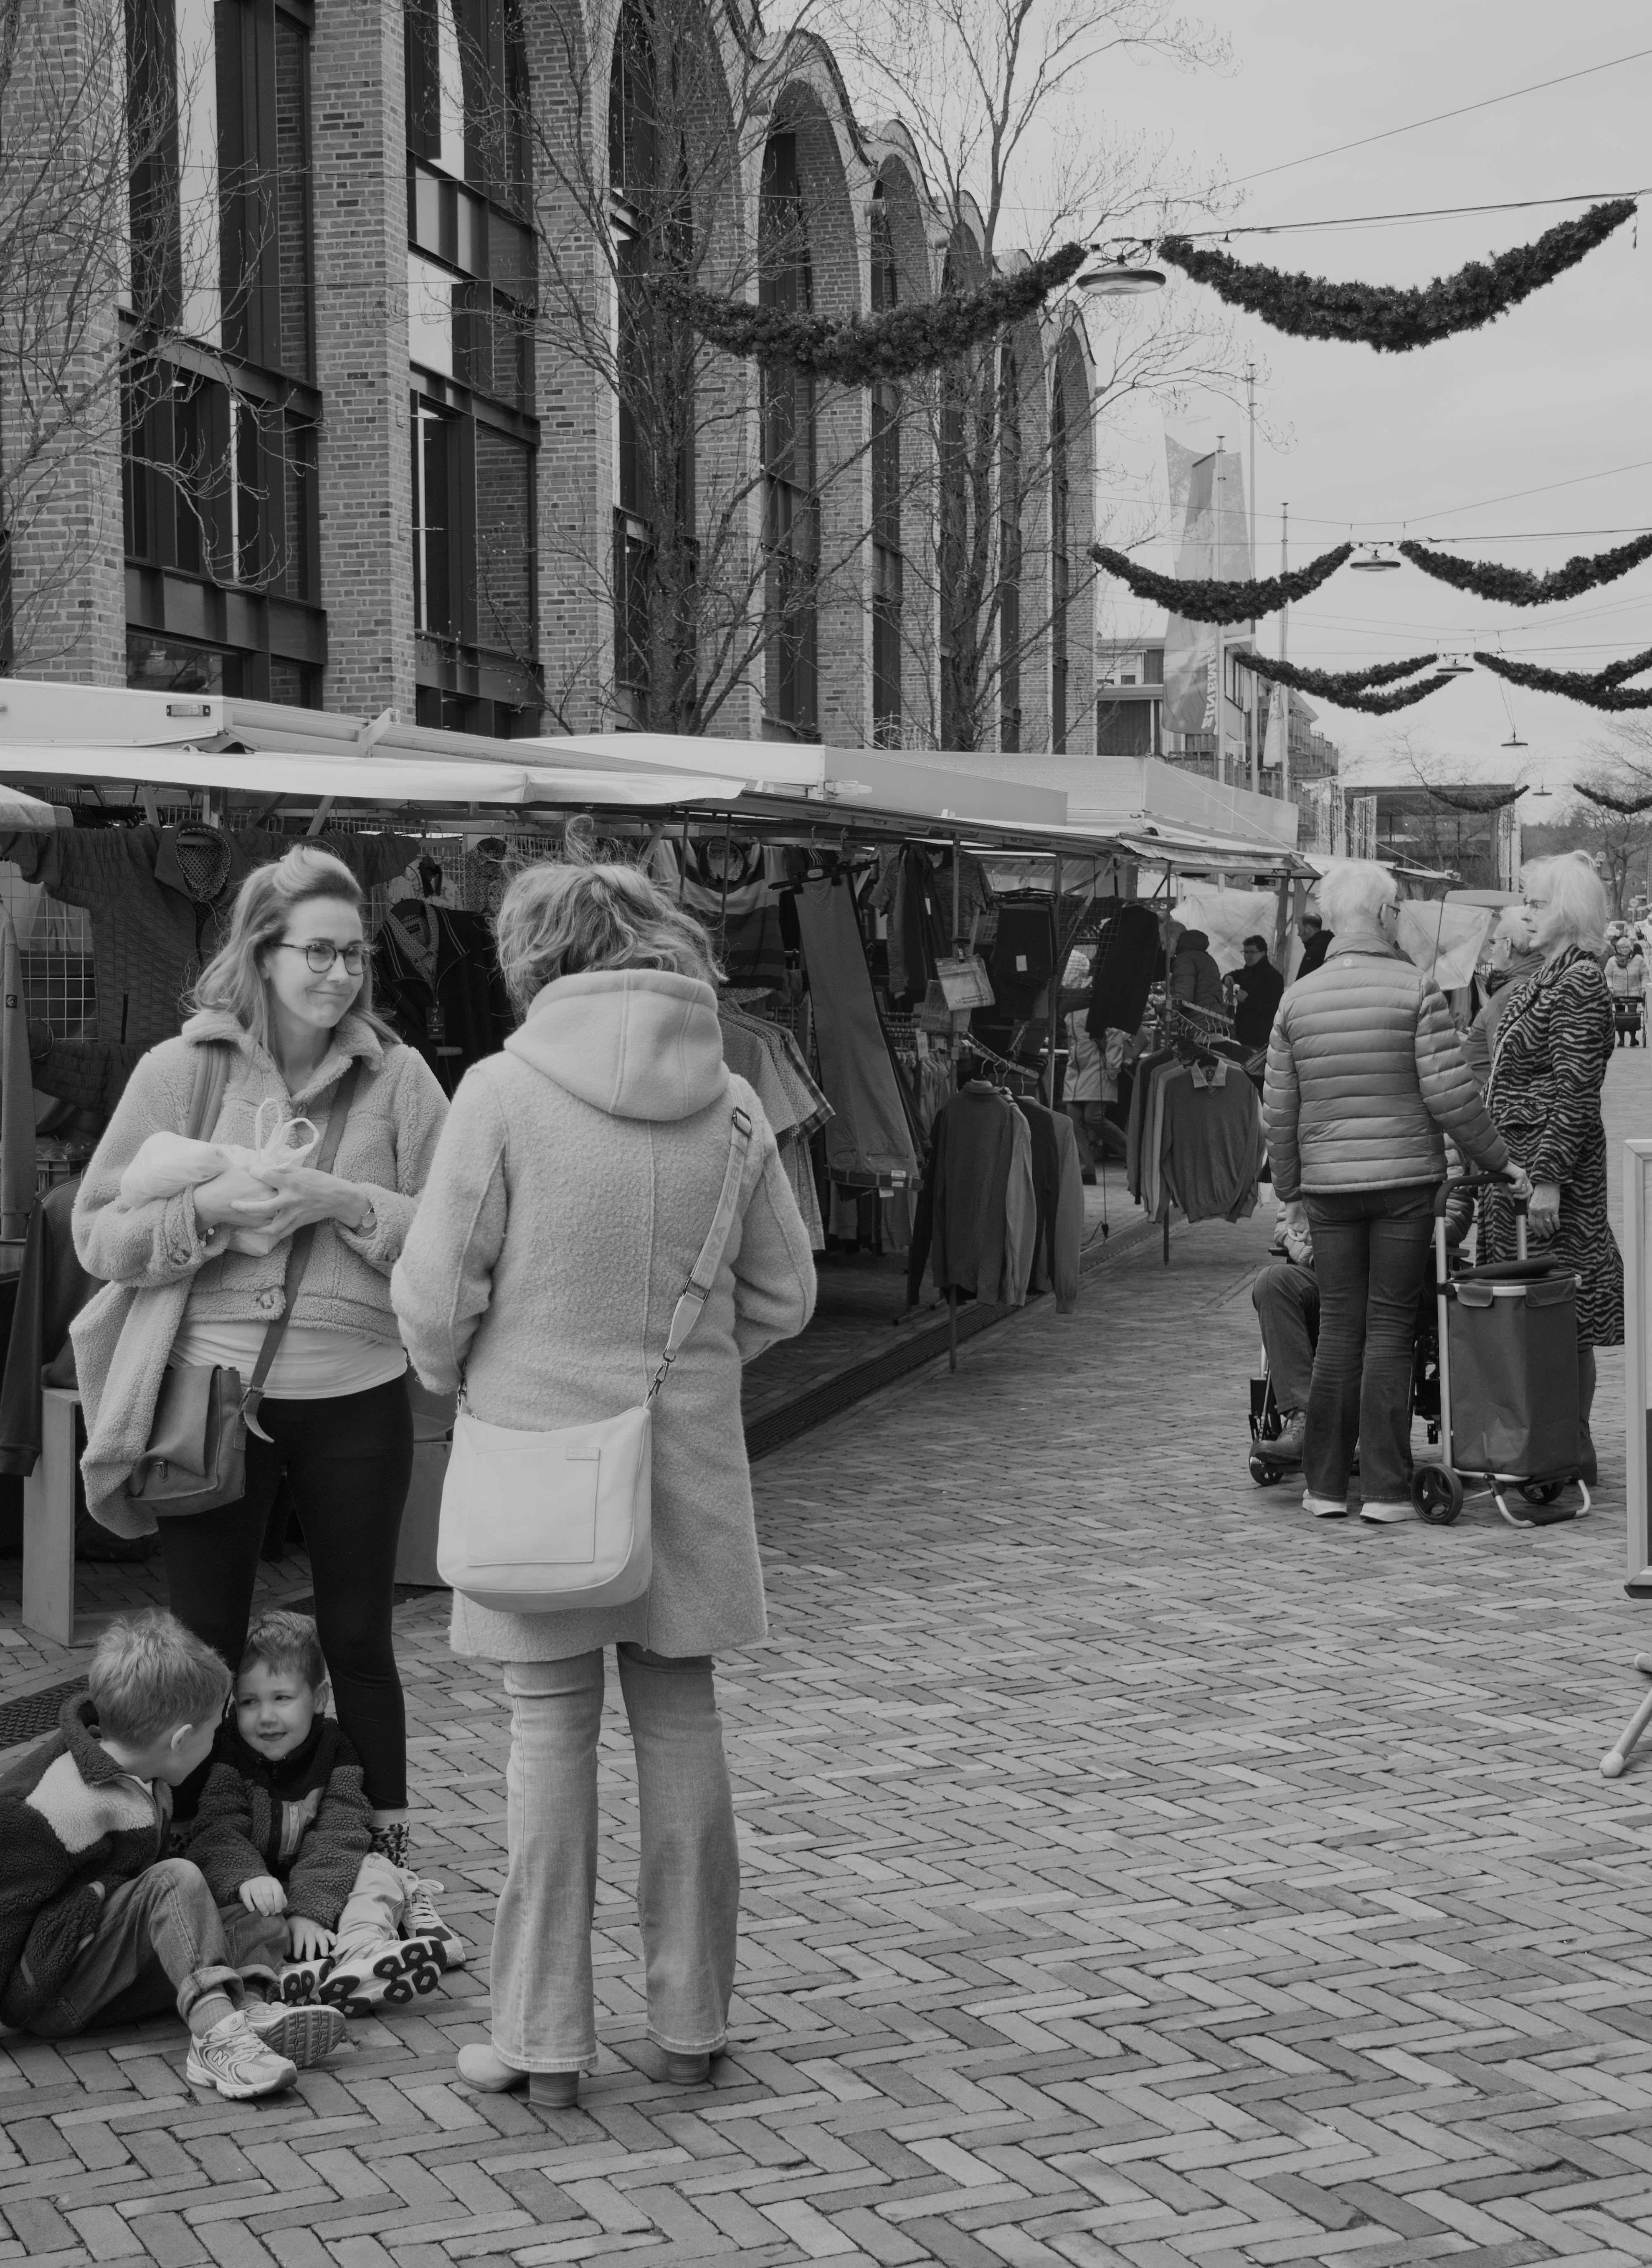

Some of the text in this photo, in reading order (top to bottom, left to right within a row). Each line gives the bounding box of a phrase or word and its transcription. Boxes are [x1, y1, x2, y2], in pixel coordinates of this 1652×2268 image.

[722, 1148, 744, 1213] ZEBR
[698, 1226, 726, 1287] EBRA
[212, 2049, 228, 2067] N
